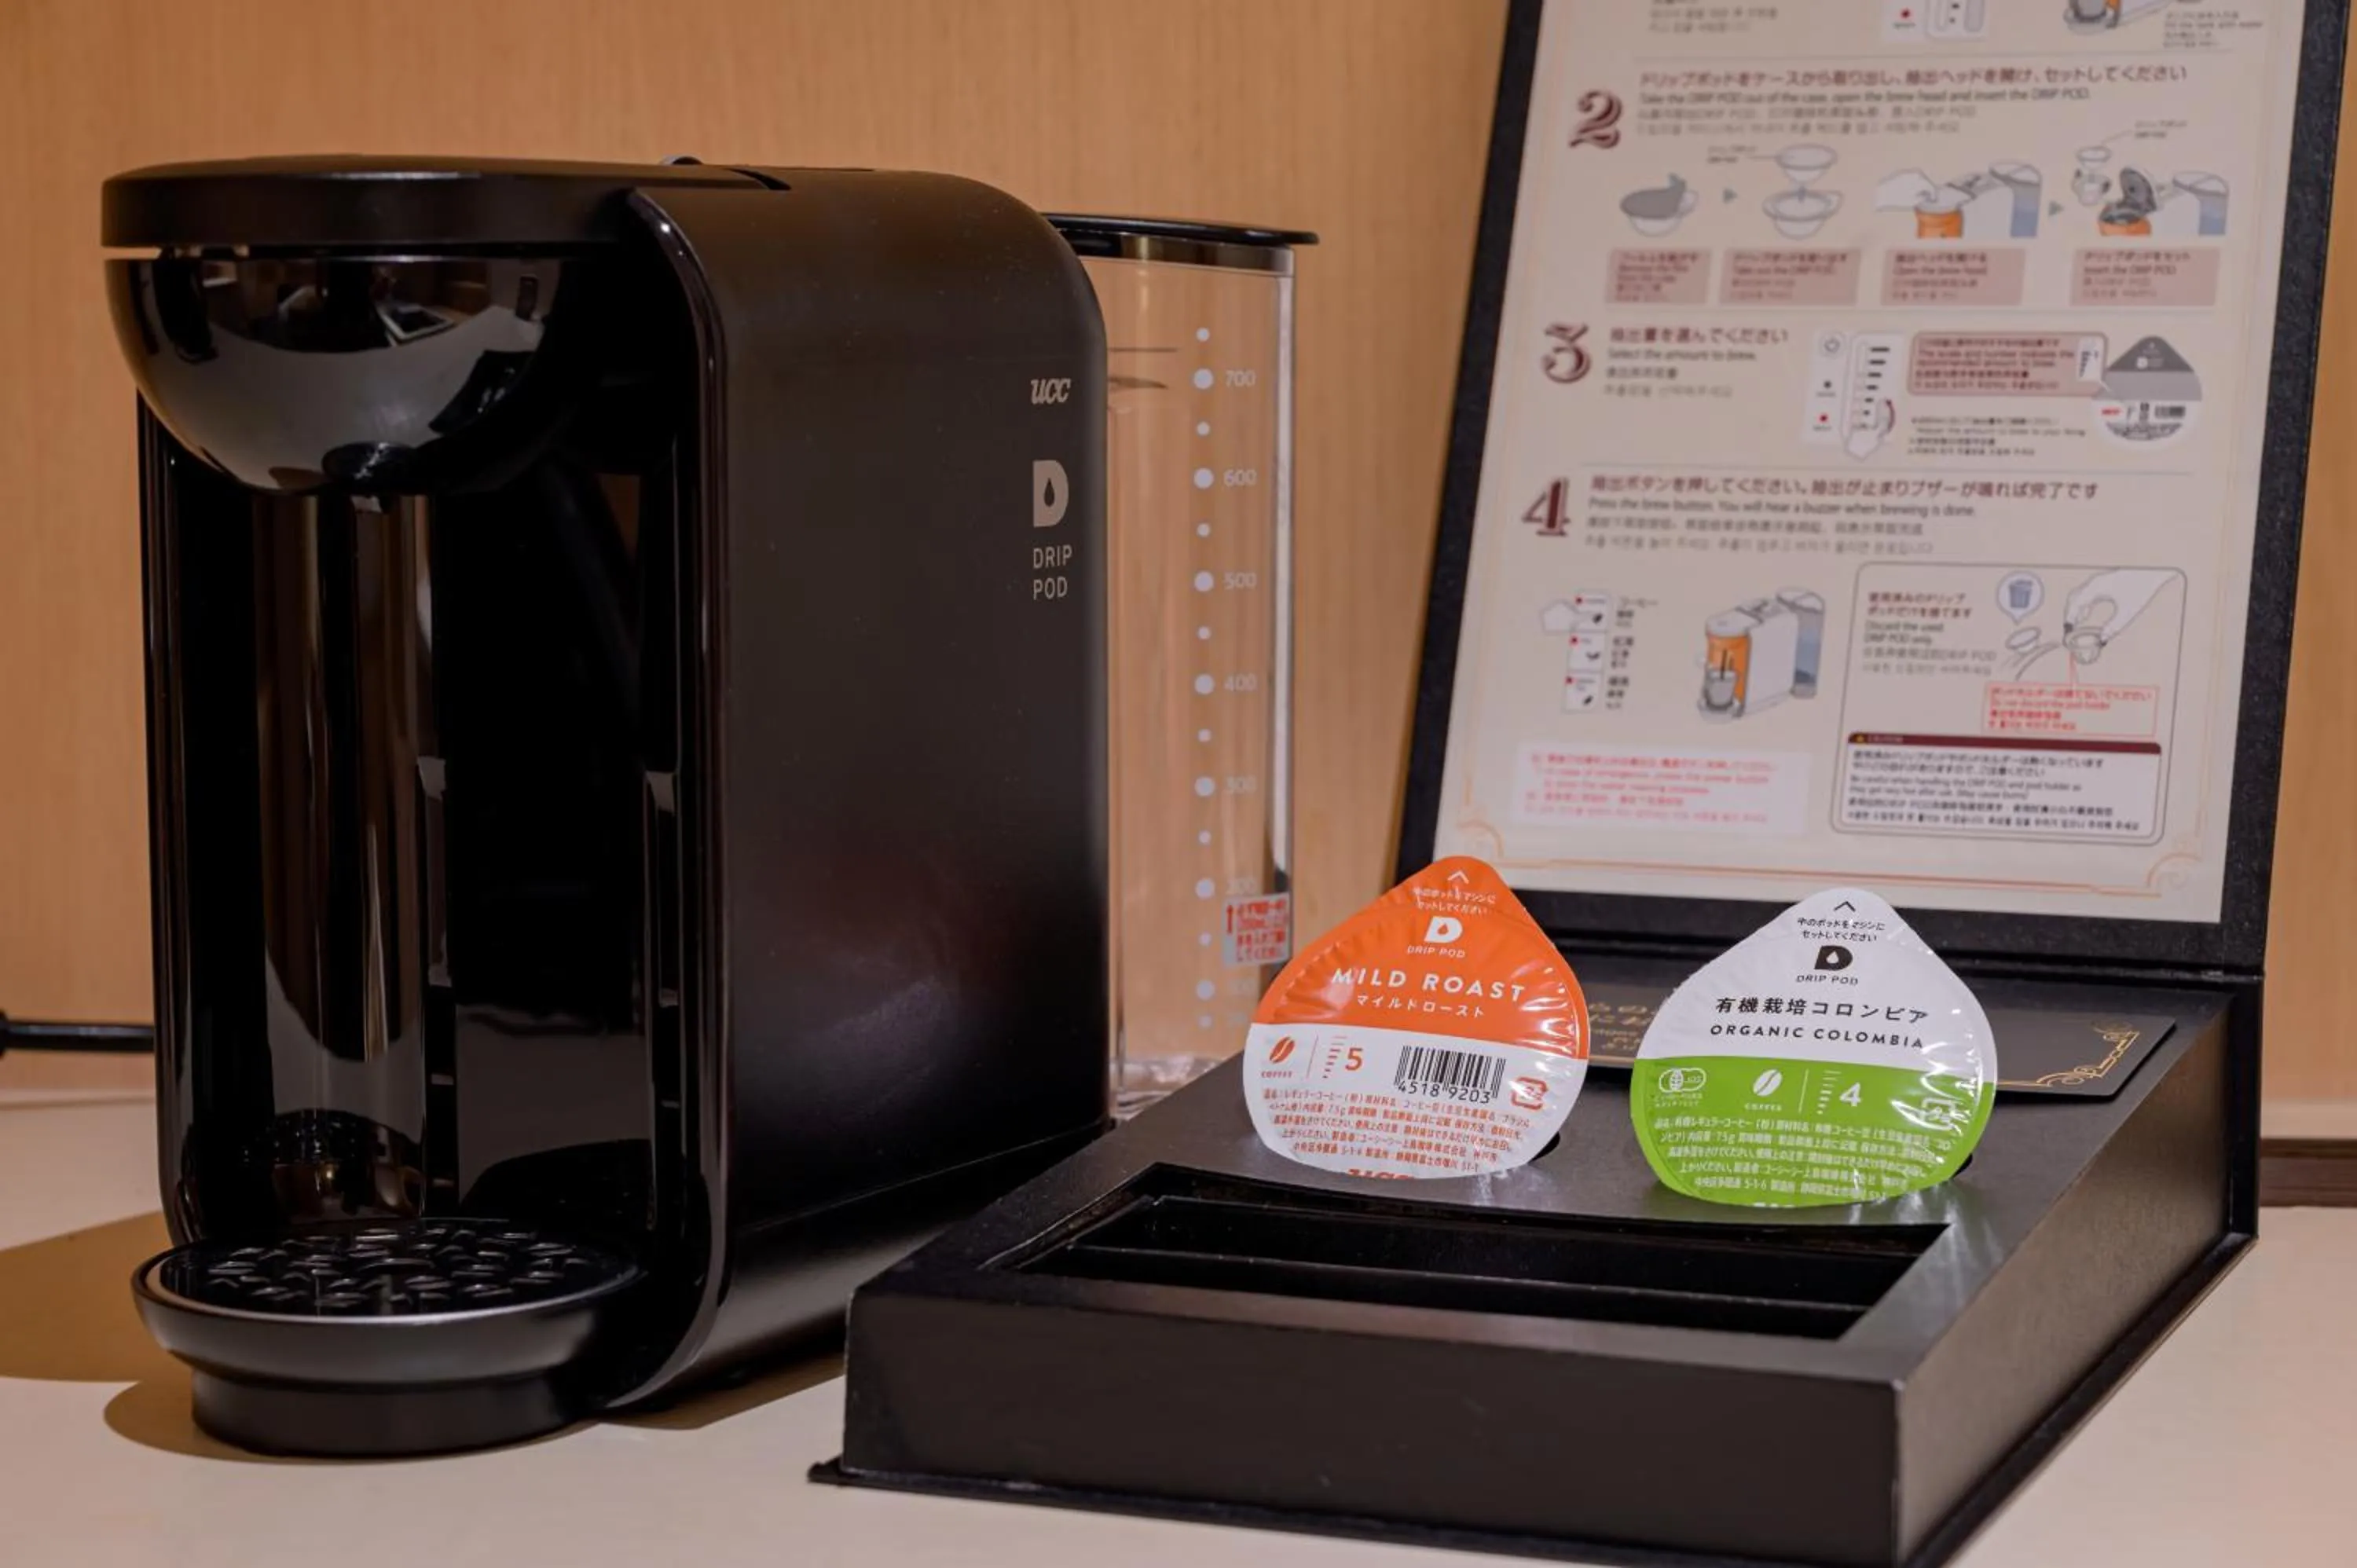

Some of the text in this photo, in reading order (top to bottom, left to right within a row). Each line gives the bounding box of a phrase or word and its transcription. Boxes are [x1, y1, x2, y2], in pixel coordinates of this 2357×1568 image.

[1569, 90, 1622, 149] 2
[1541, 322, 1591, 384] 3
[1224, 370, 1255, 387] 700
[1223, 470, 1256, 487] 600
[1521, 475, 1571, 537] 4
[1032, 544, 1073, 570] DRIP
[1032, 577, 1069, 600] POD
[1223, 573, 1256, 590] 500
[1223, 675, 1256, 692] 400
[1797, 917, 1886, 931] 中のポッドをマシンに
[1802, 929, 1878, 942] セットしてください
[1407, 944, 1466, 958] DRIP POD
[1331, 967, 1525, 1002] MILD ROAST
[1795, 974, 1859, 986] DRIP POD
[1356, 993, 1485, 1018] マイルドロースト
[1715, 996, 1930, 1024] 有機栽培コロンビア
[1710, 1024, 1924, 1050] ORGANIC COLOMBIA
[1344, 1047, 1364, 1072] 5
[1398, 1079, 1491, 1104] 4518 9203
[1839, 1082, 1862, 1108] 4
